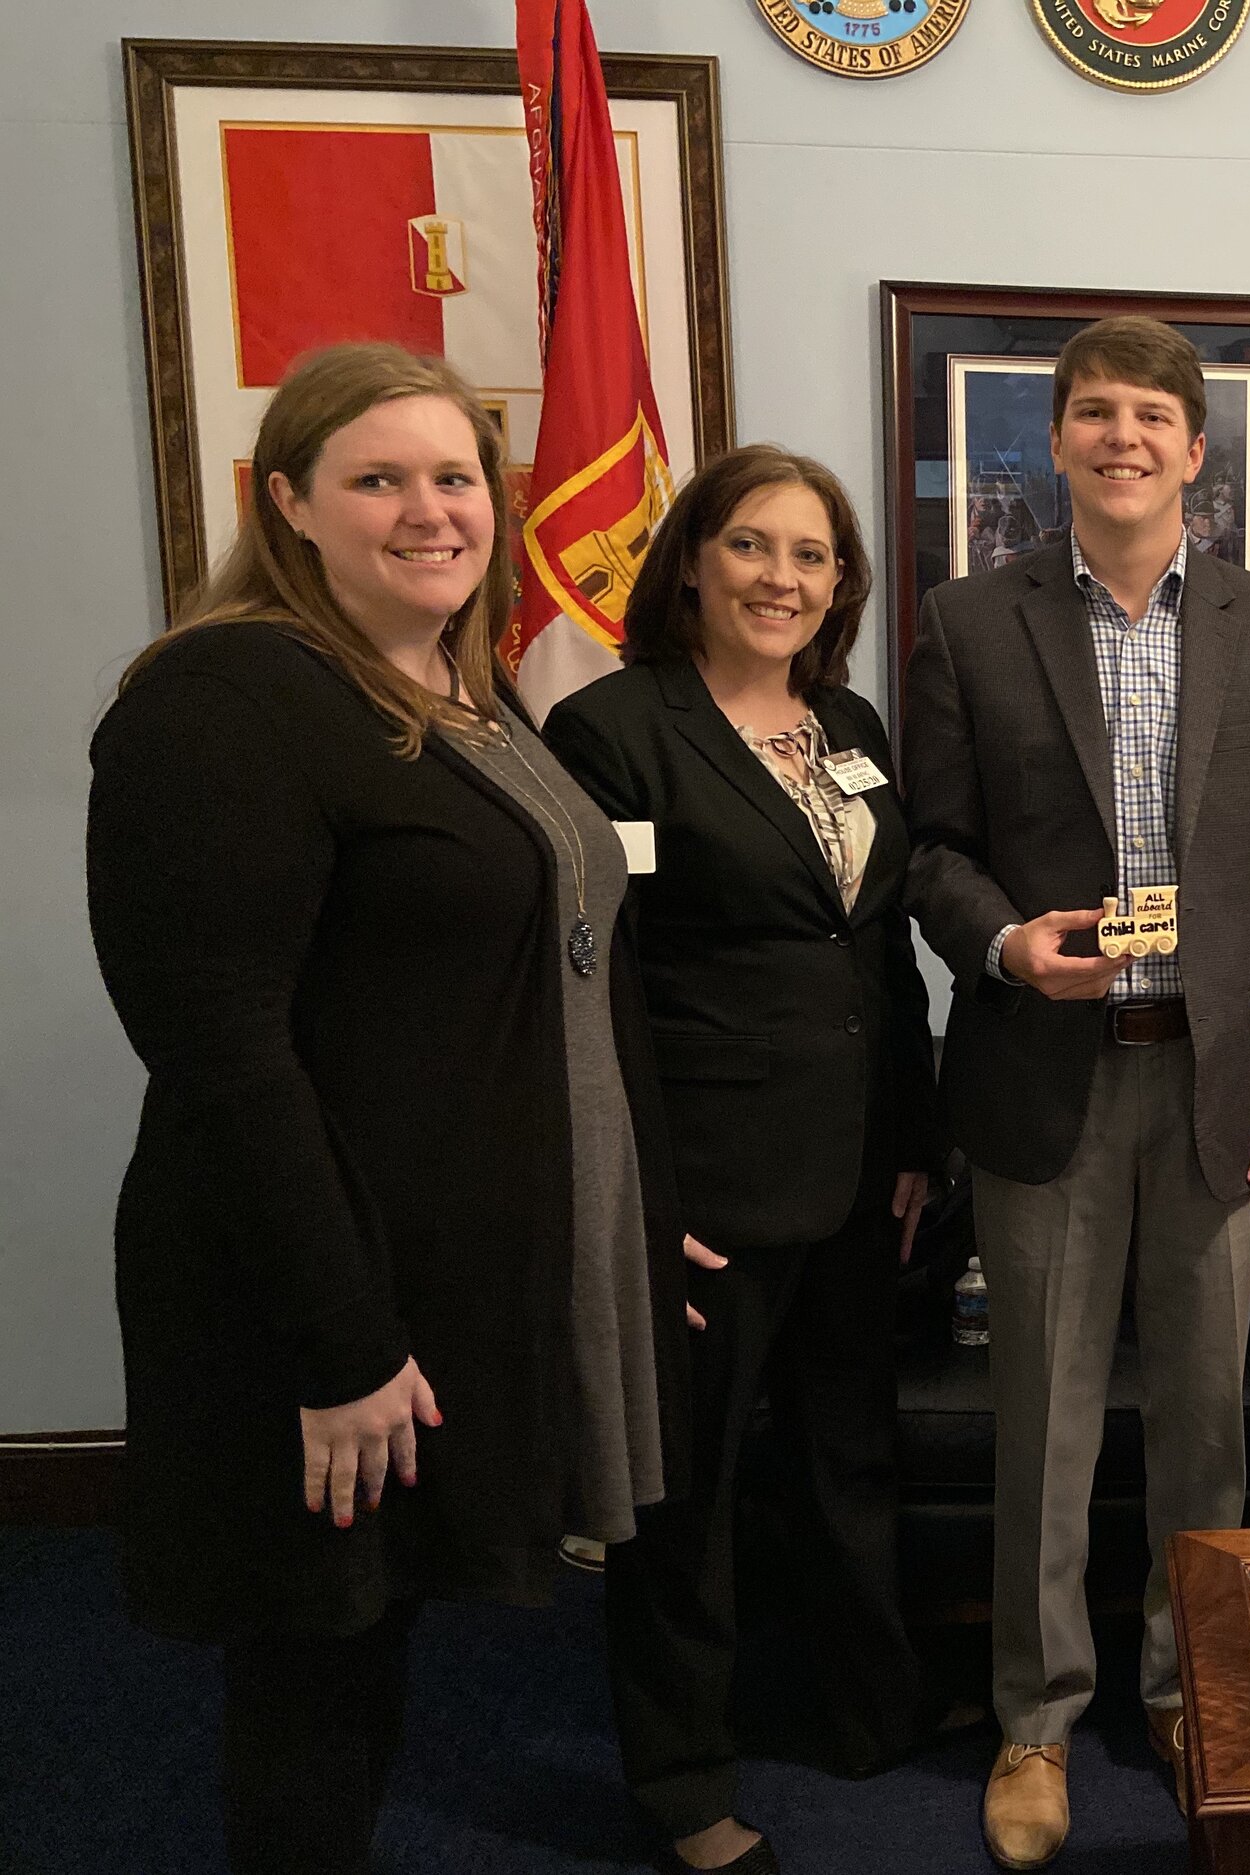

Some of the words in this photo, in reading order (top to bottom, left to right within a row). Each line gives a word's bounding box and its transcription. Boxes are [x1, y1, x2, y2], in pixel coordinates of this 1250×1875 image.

[801, 30, 871, 69] STATES
[879, 43, 902, 67] OF
[910, 0, 960, 56] AMERI
[843, 21, 882, 38] 1775
[1088, 39, 1141, 68] STATES
[1152, 33, 1208, 68] MARINE
[1137, 900, 1173, 912] aboard
[1145, 893, 1165, 902] ALL
[1101, 921, 1135, 937] child
[1139, 918, 1175, 933] care!
